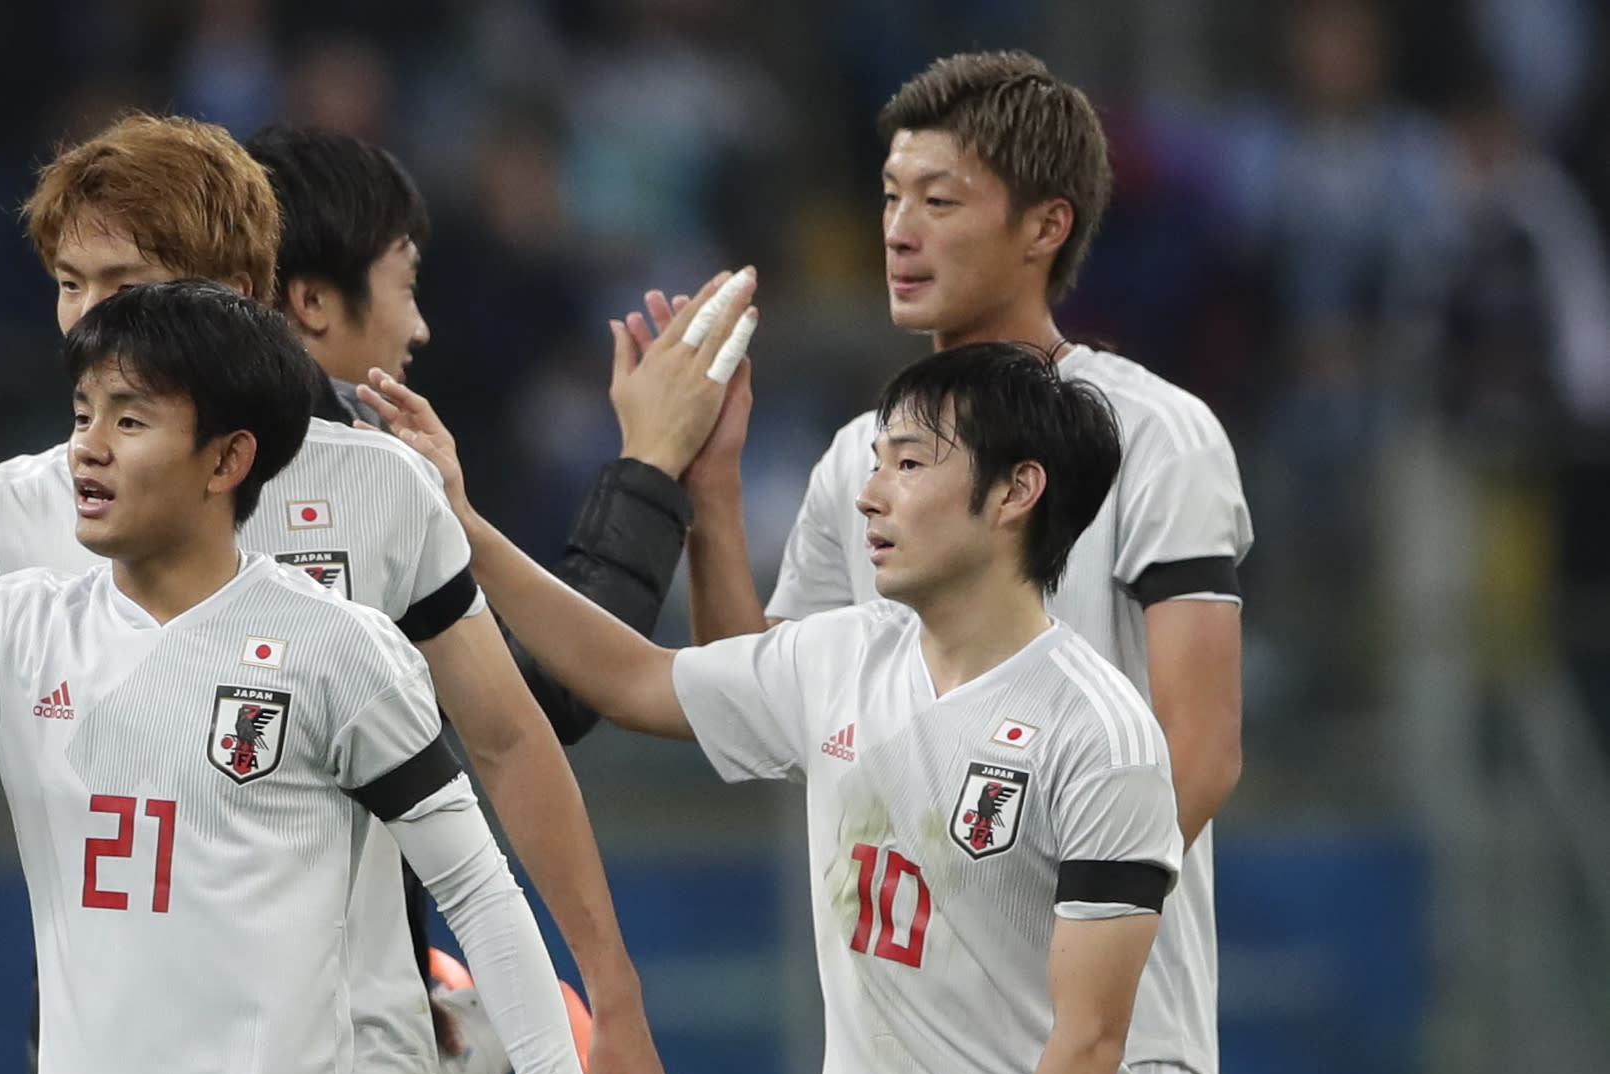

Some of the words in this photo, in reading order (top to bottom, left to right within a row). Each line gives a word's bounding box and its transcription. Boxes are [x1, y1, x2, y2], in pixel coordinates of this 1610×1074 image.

[293, 552, 332, 563] JAPAN
[233, 688, 274, 701] JAPAN
[33, 704, 74, 720] adidas
[225, 752, 259, 770] JFA
[821, 742, 856, 762] adidas
[981, 766, 1015, 780] JAPAN
[963, 826, 995, 846] JFA
[81, 793, 177, 914] 21
[849, 842, 932, 970] 10
